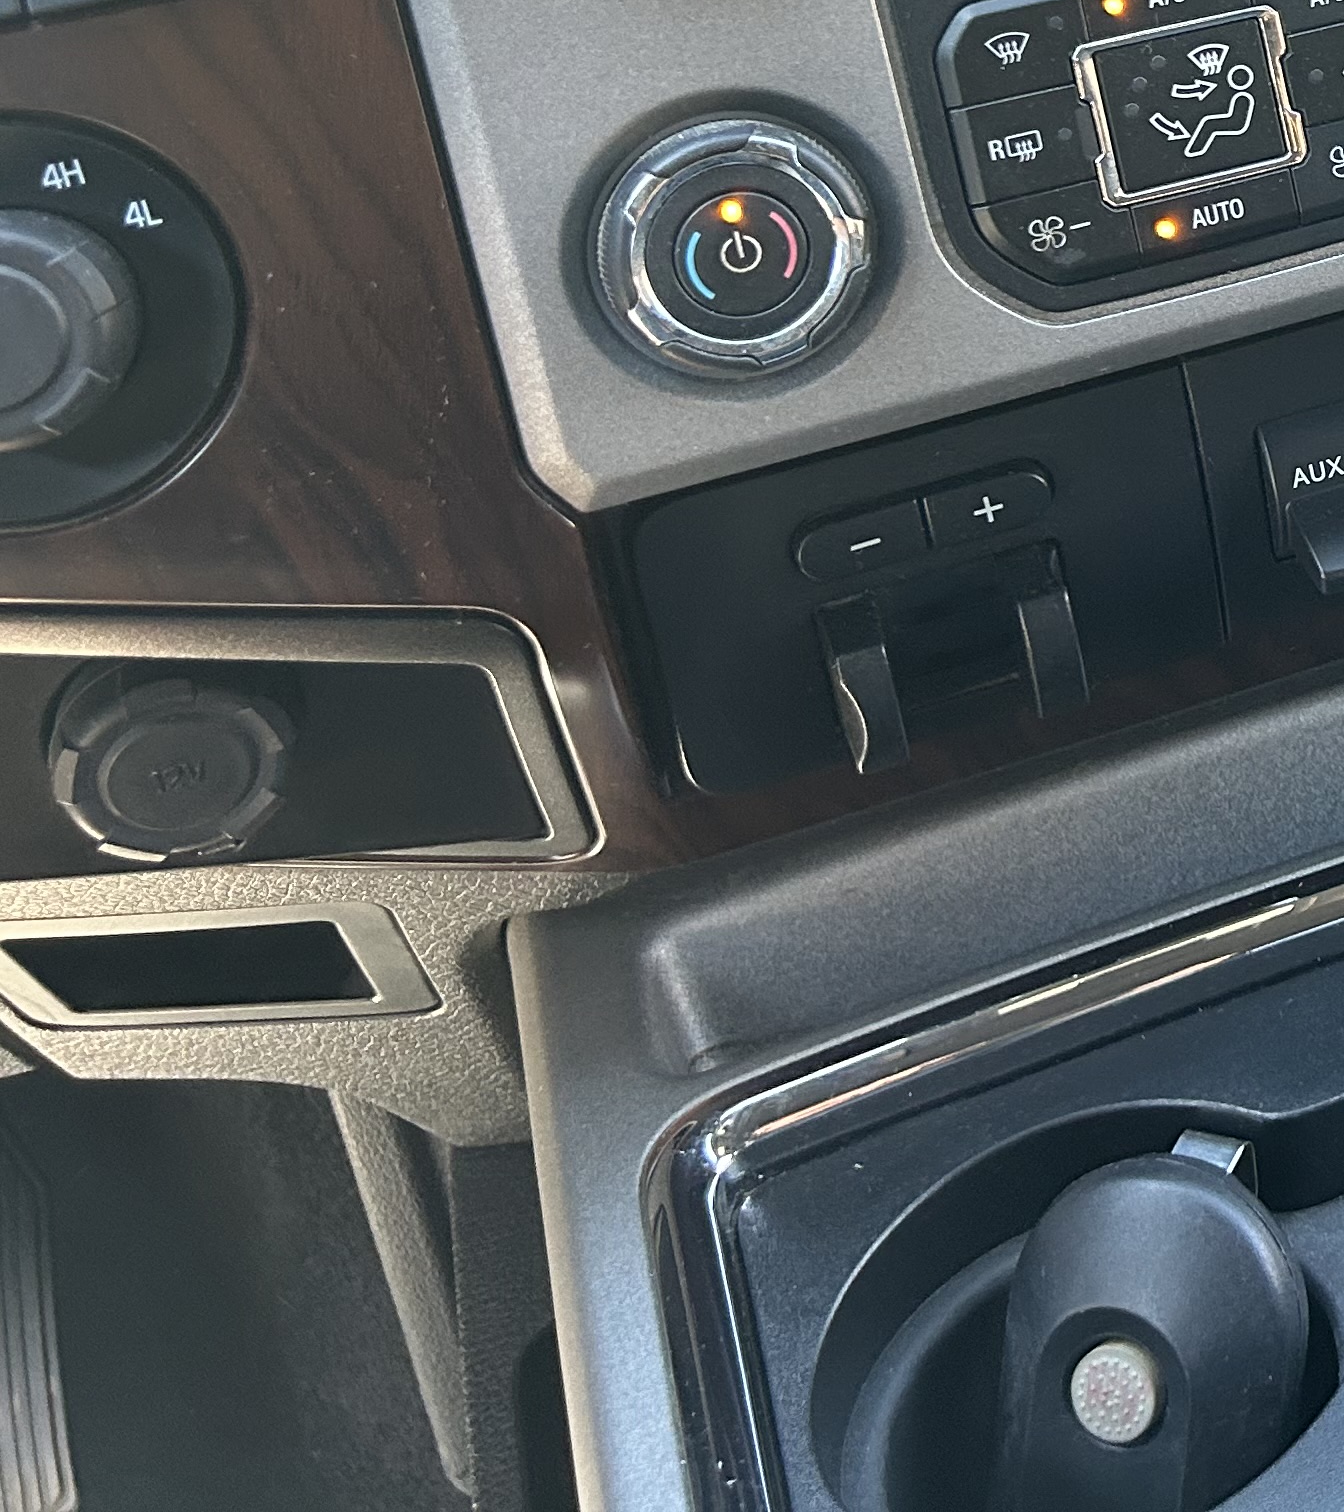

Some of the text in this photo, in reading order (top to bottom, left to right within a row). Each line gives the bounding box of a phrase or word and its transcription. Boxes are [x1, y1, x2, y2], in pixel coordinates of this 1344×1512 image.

[988, 140, 1005, 161] R
[41, 158, 86, 190] 4H
[123, 199, 163, 230] 4L
[1191, 198, 1246, 230] AUTO
[1291, 455, 1344, 489] AUX
